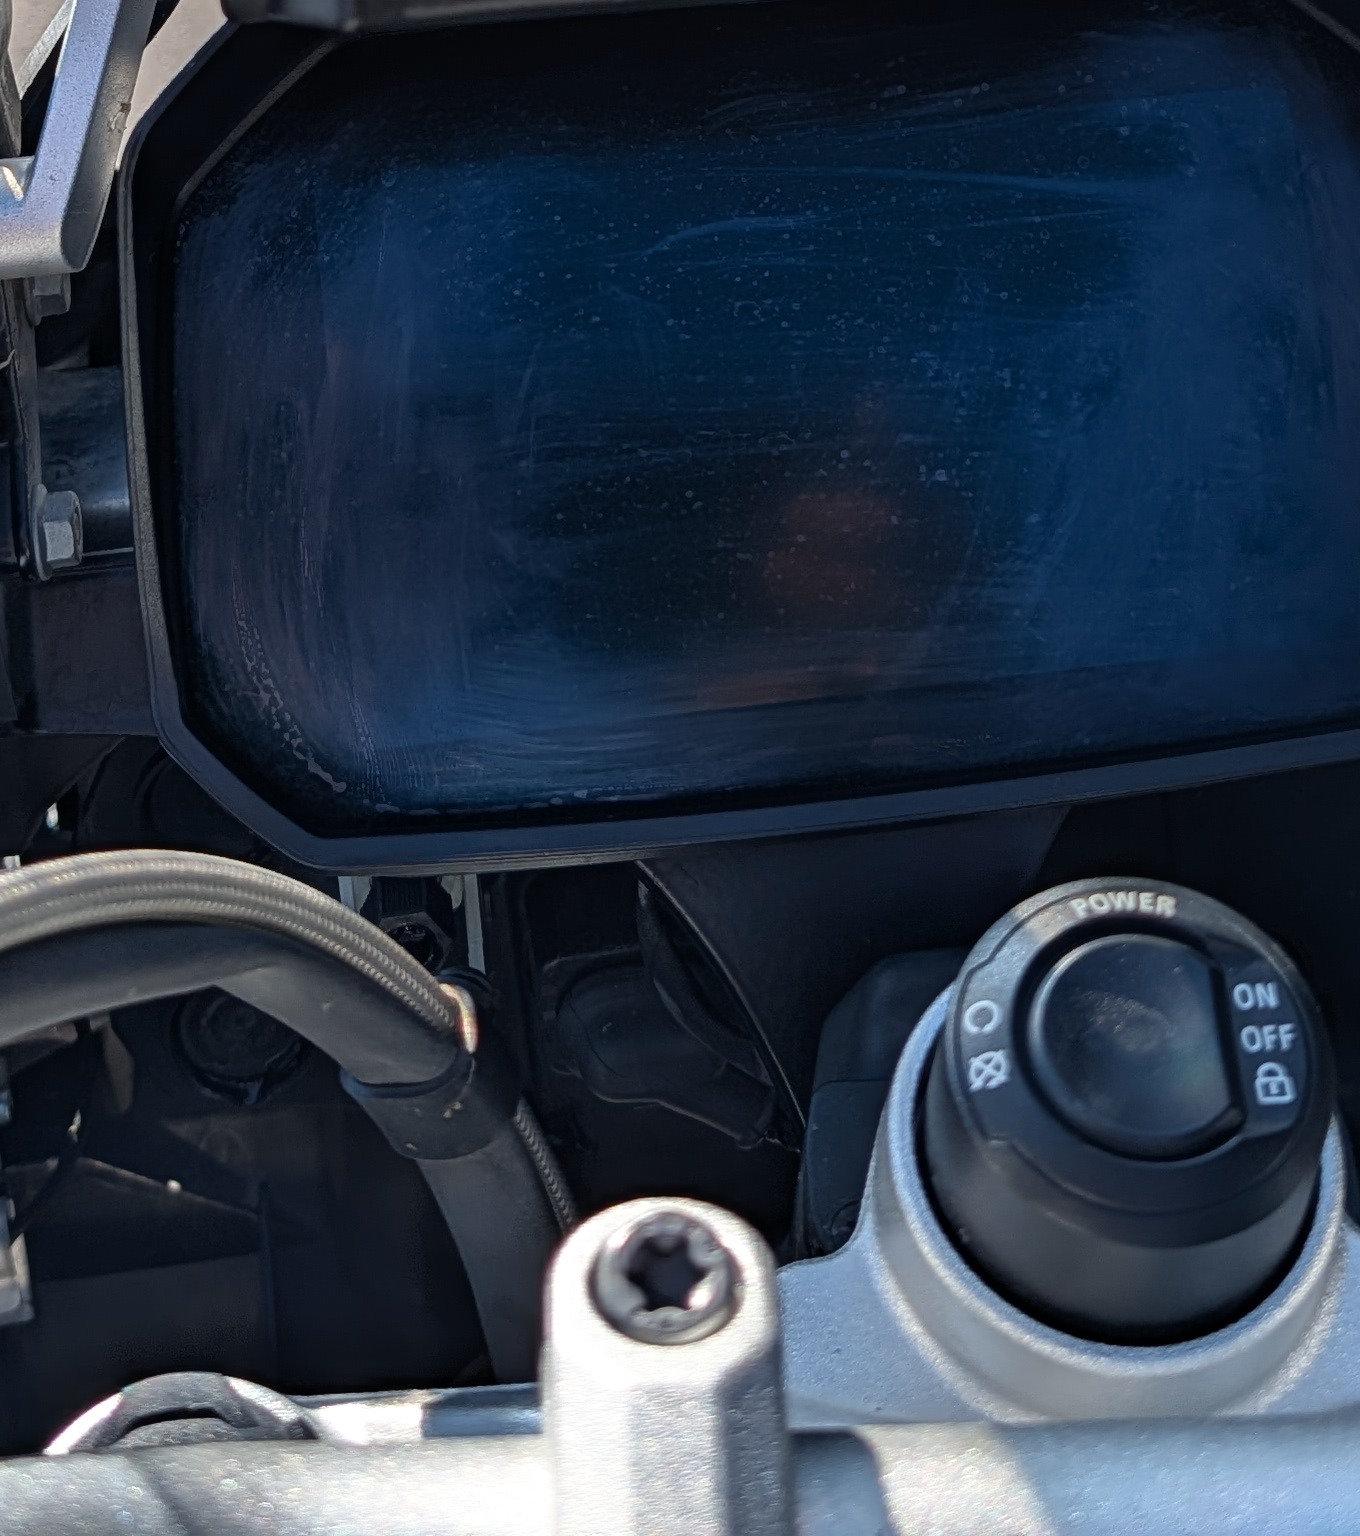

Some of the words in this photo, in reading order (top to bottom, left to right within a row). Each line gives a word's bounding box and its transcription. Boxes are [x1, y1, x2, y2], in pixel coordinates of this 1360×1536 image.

[1069, 890, 1178, 919] POWER
[1232, 981, 1280, 1011] ON
[1239, 1022, 1297, 1053] OFF
